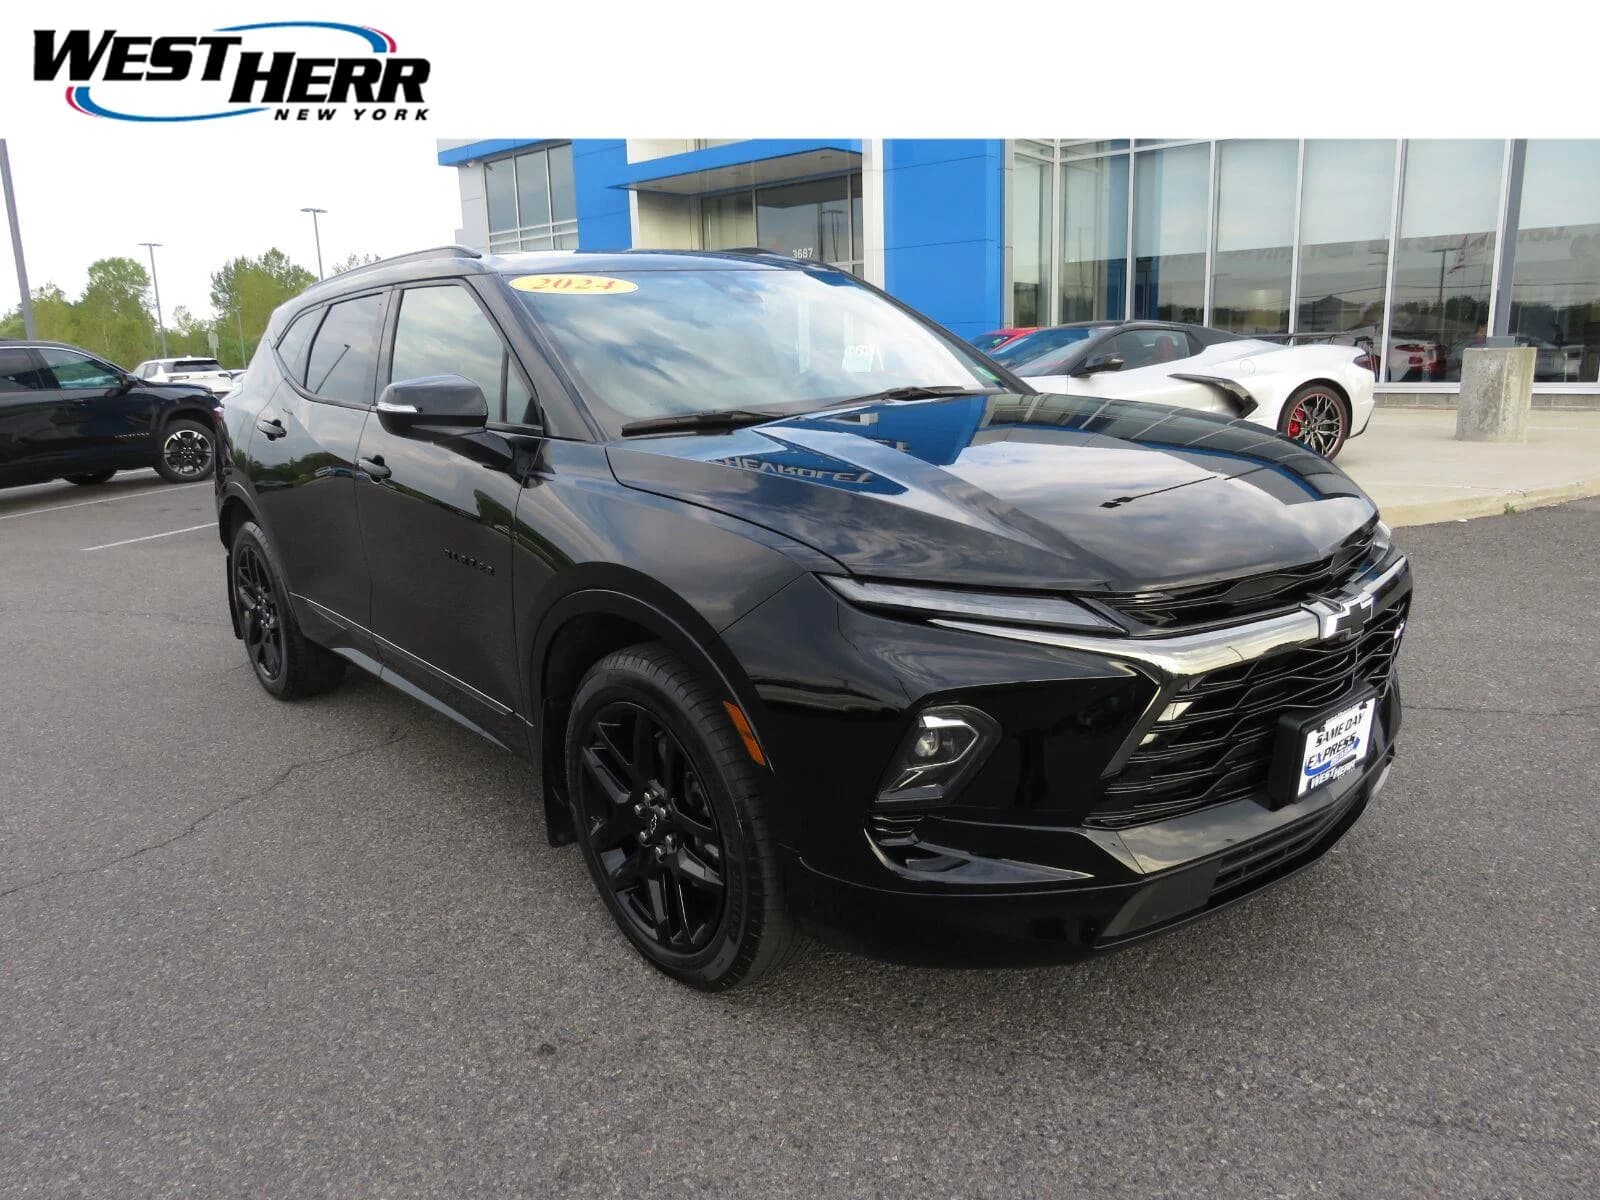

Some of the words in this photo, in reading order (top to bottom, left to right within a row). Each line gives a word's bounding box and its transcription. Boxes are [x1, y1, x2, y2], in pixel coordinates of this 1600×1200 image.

[792, 247, 814, 259] 3687
[532, 278, 616, 290] 2024
[1315, 722, 1345, 748] SAME
[1345, 713, 1364, 730] DAY
